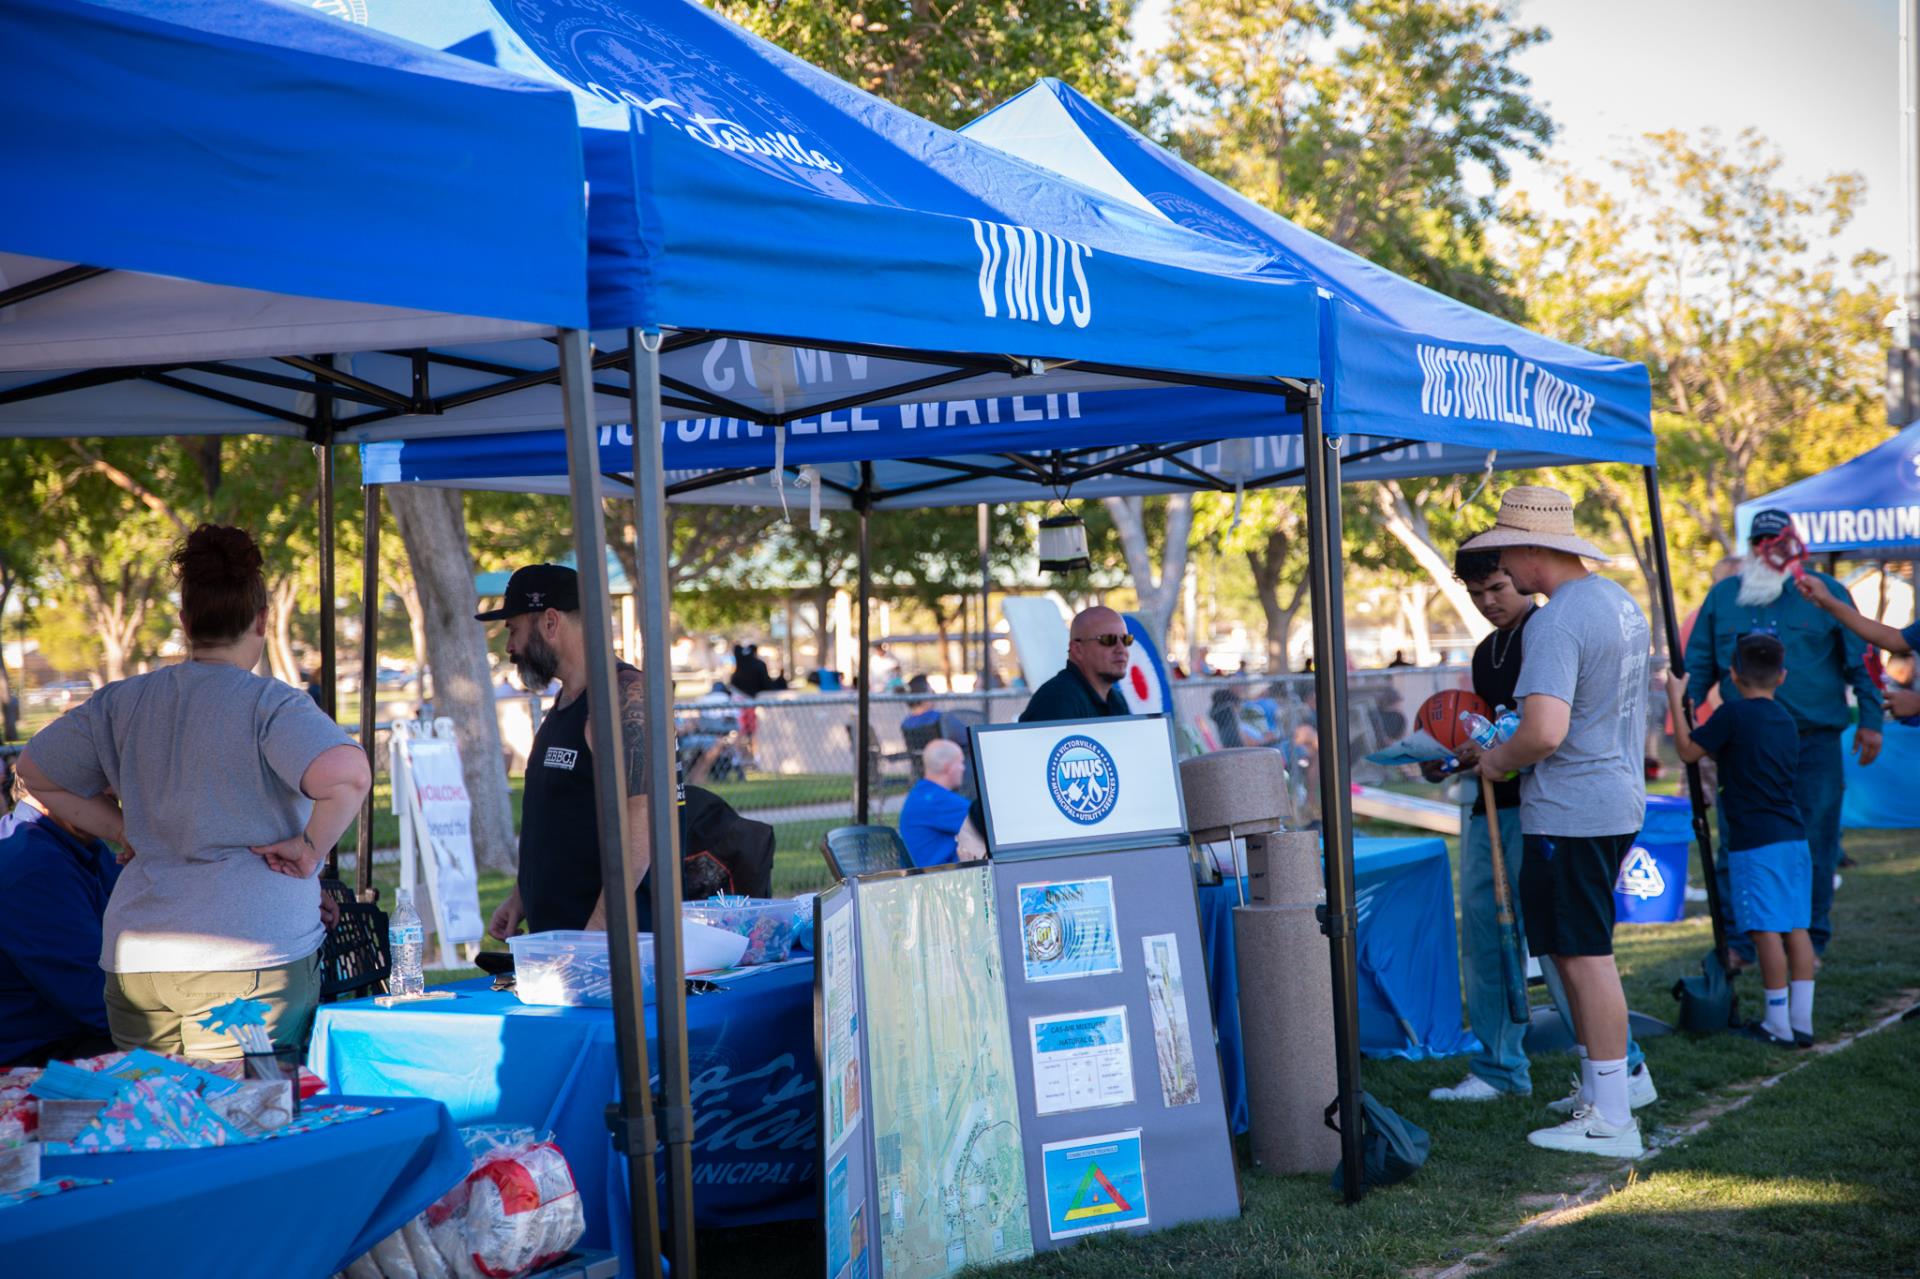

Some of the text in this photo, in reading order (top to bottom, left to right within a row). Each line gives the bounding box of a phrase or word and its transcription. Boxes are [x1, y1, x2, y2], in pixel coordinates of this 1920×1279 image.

[552, 0, 804, 135] CTORVILLE
[968, 218, 1093, 329] VMUS
[1417, 343, 1596, 437] VICTORVILLE WATER
[1790, 505, 1920, 545] NVIRONM
[1060, 759, 1104, 779] VMUS
[1079, 812, 1102, 821] UTILITY
